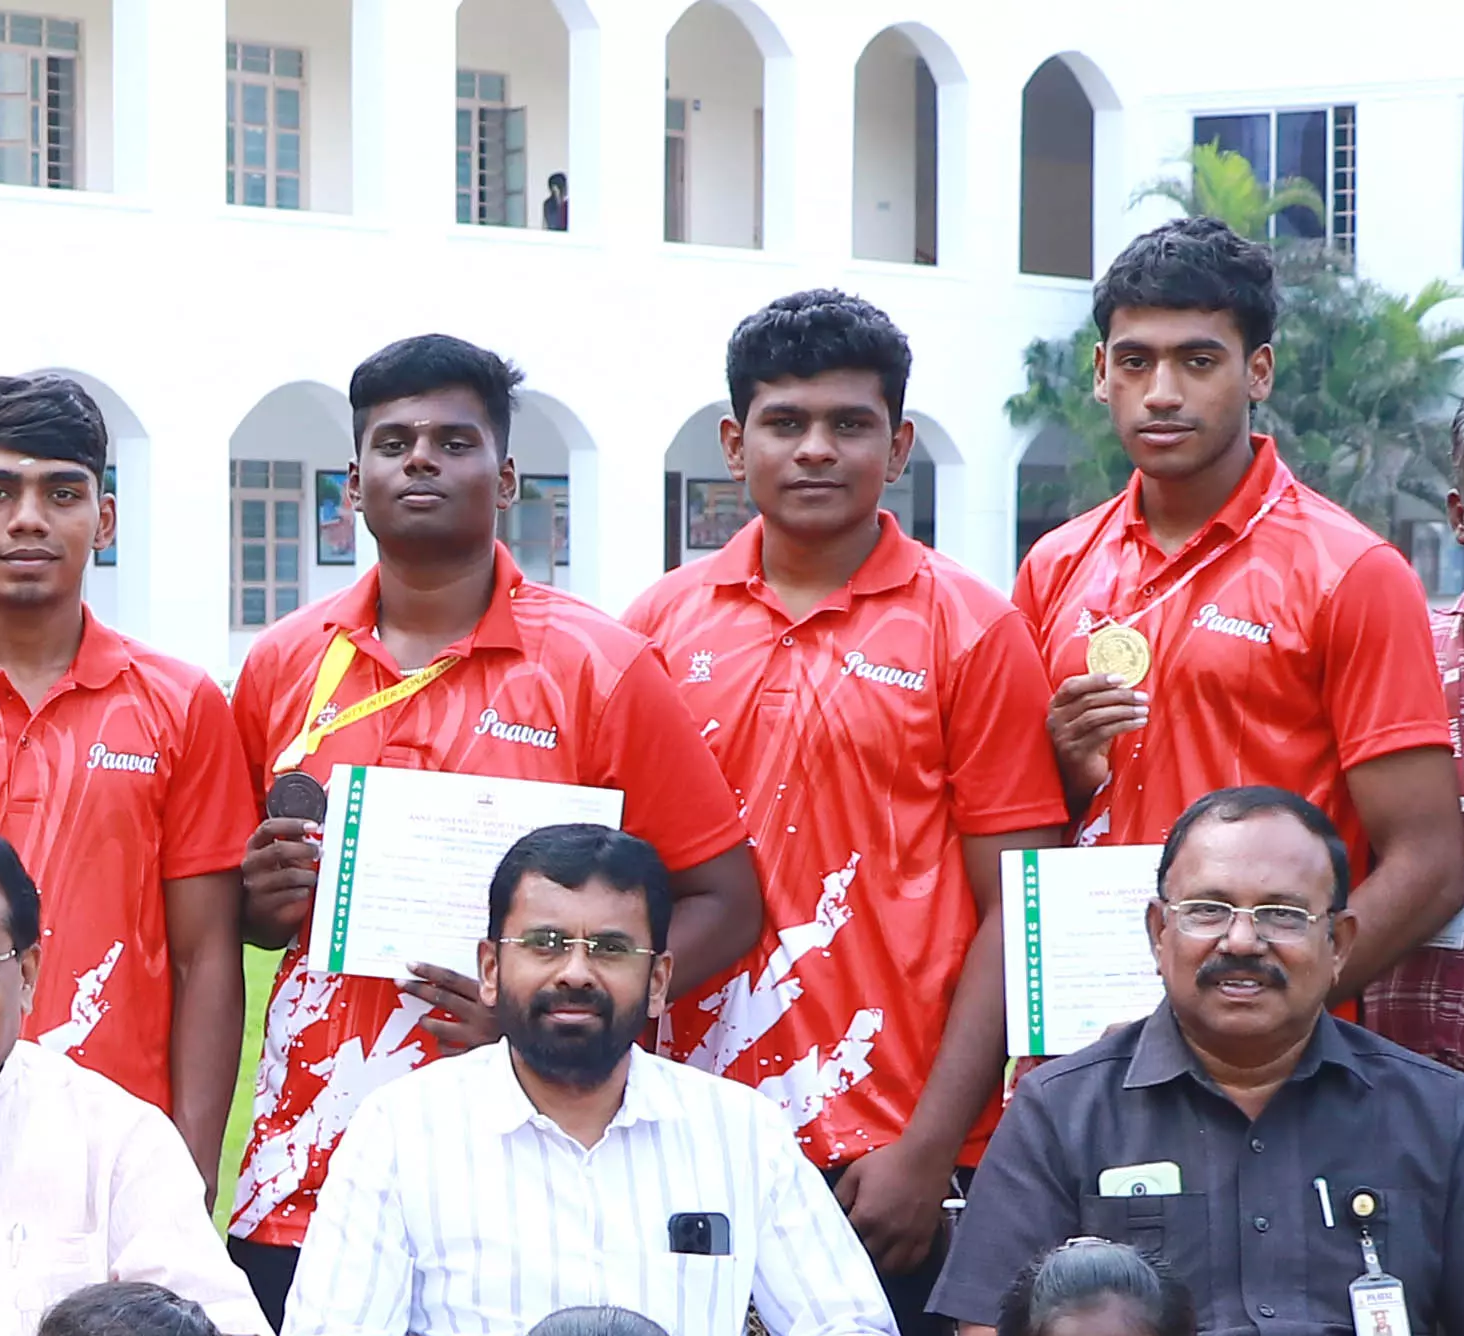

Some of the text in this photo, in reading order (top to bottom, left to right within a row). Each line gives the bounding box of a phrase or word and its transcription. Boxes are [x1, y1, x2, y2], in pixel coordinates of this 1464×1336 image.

[1191, 602, 1274, 645] Paavai
[840, 651, 928, 692] Paavai
[366, 690, 398, 708] INTER
[474, 707, 559, 750] Paavai
[87, 742, 160, 775] Paavai
